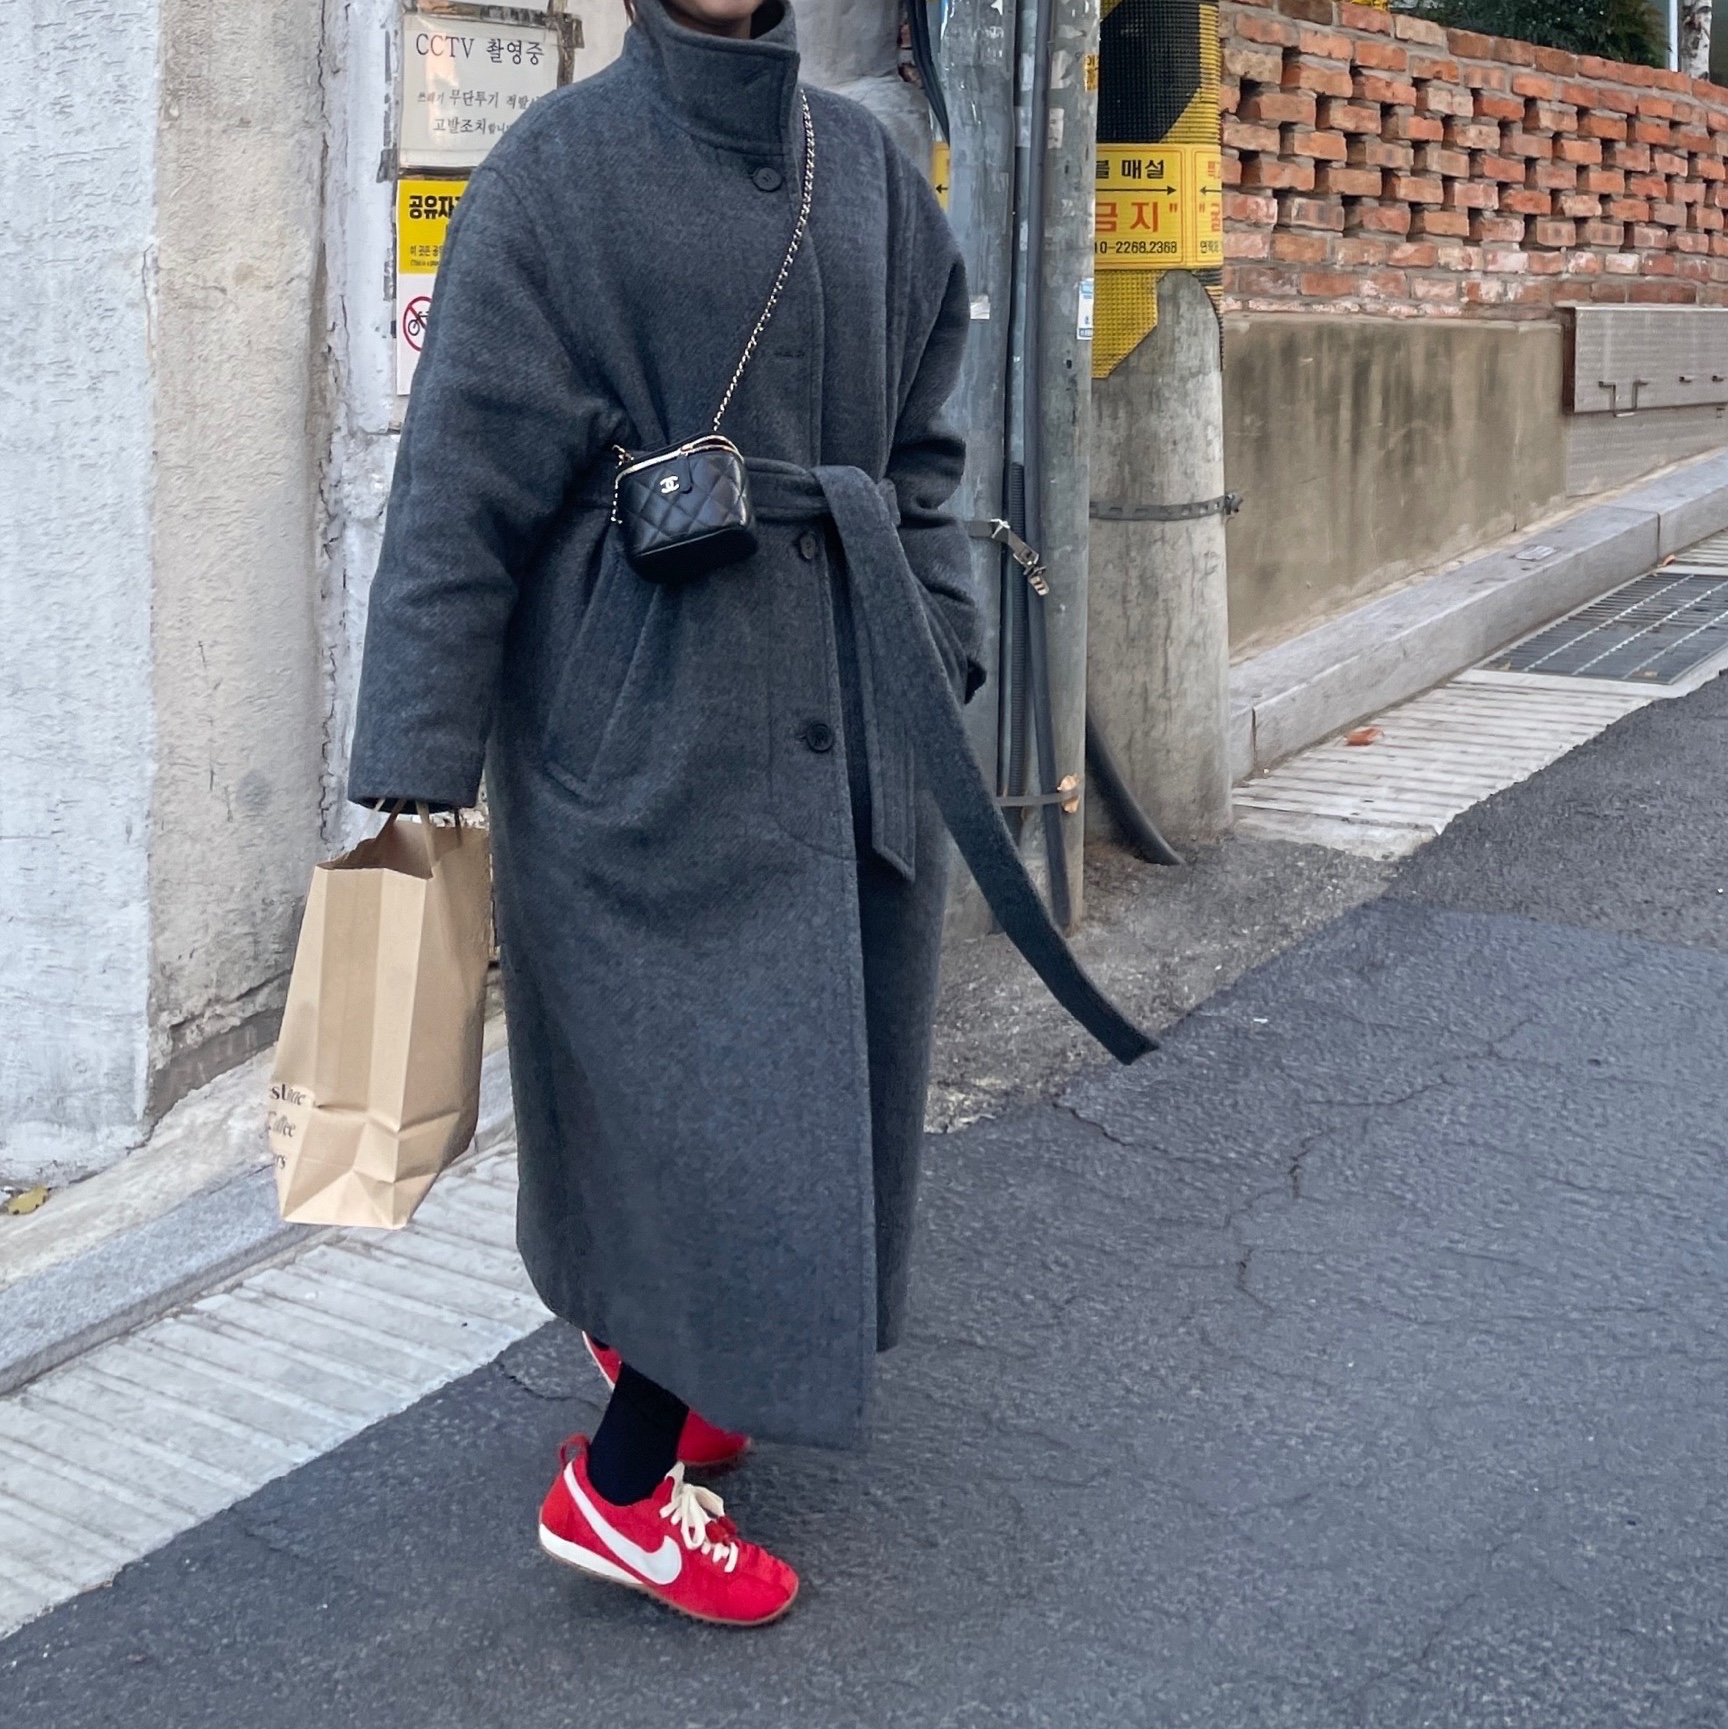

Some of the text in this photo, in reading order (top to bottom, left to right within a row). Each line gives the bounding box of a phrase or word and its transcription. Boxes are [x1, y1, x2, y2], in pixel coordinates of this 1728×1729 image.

[416, 33, 545, 66] CCTV 촬영중
[449, 88, 499, 109] 무단투기
[506, 93, 536, 110] 적발
[1121, 159, 1165, 180] 매설
